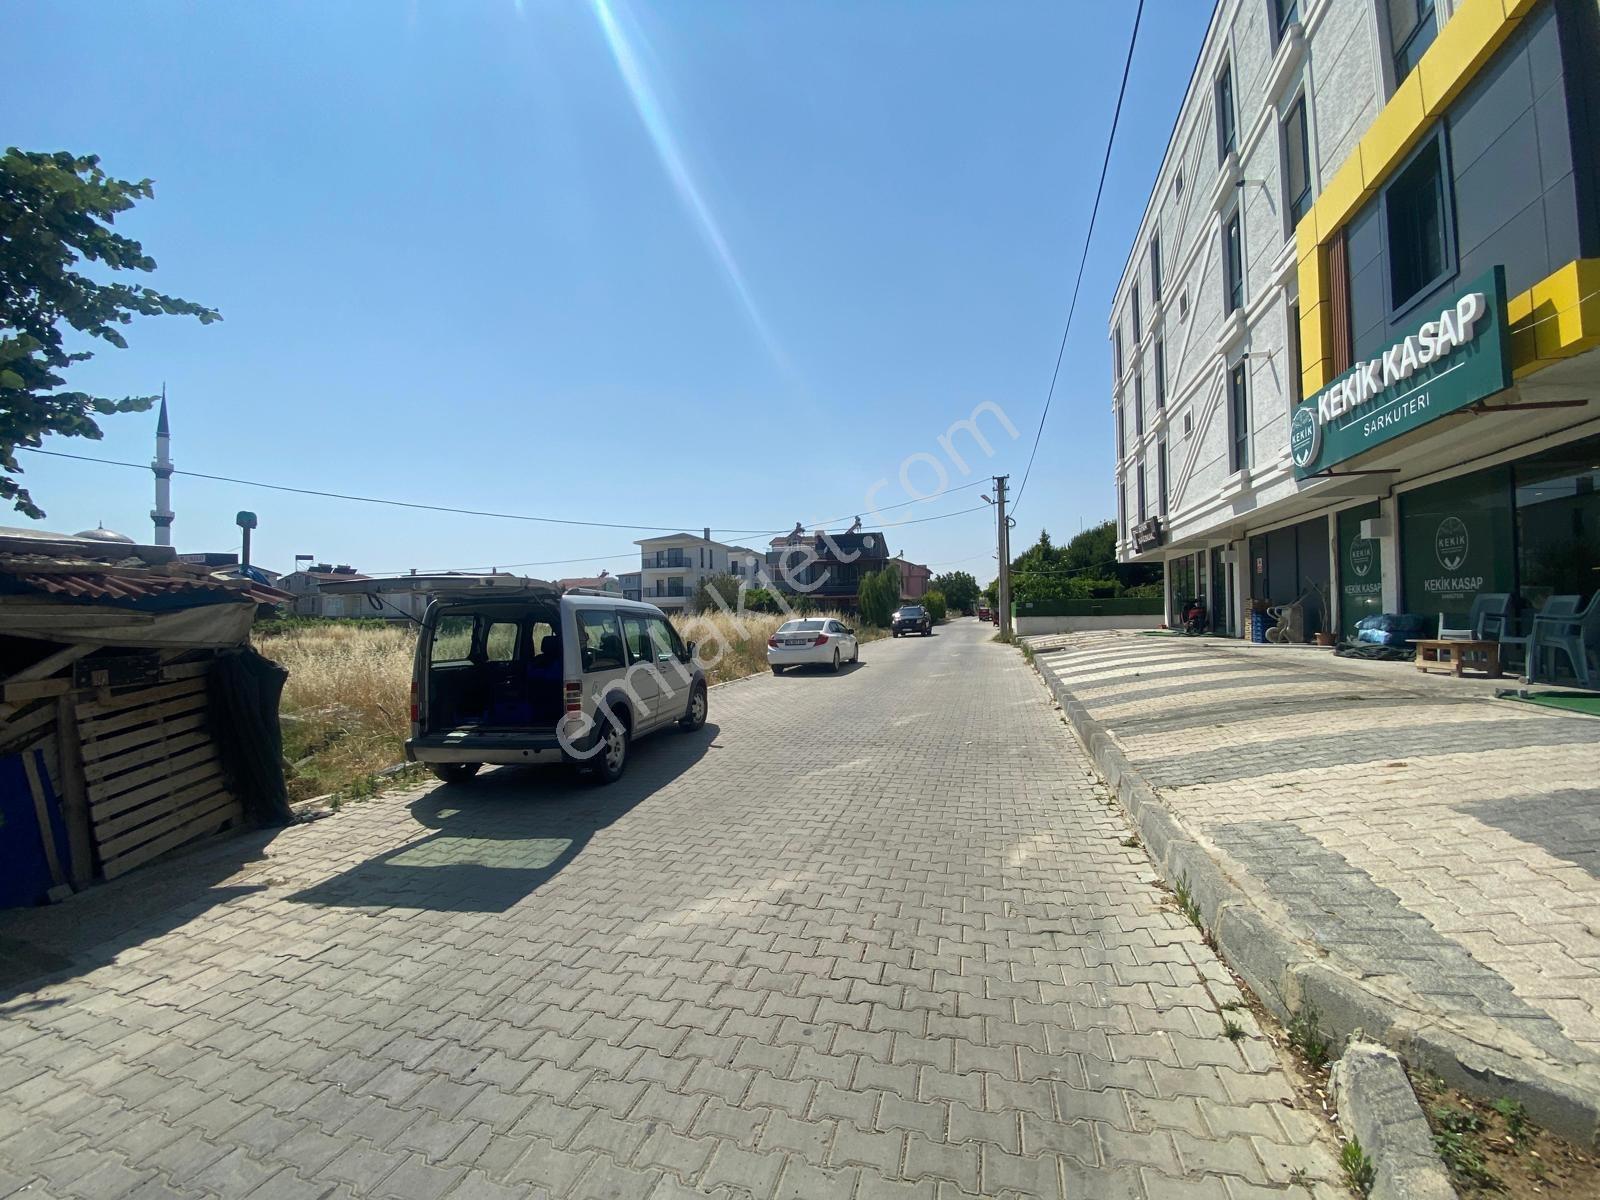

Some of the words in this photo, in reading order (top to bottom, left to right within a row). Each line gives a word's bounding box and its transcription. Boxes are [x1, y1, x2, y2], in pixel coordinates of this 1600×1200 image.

[1318, 359, 1384, 425] KEKİK
[1383, 293, 1485, 387] KASAP
[1451, 577, 1483, 590] KASAP
